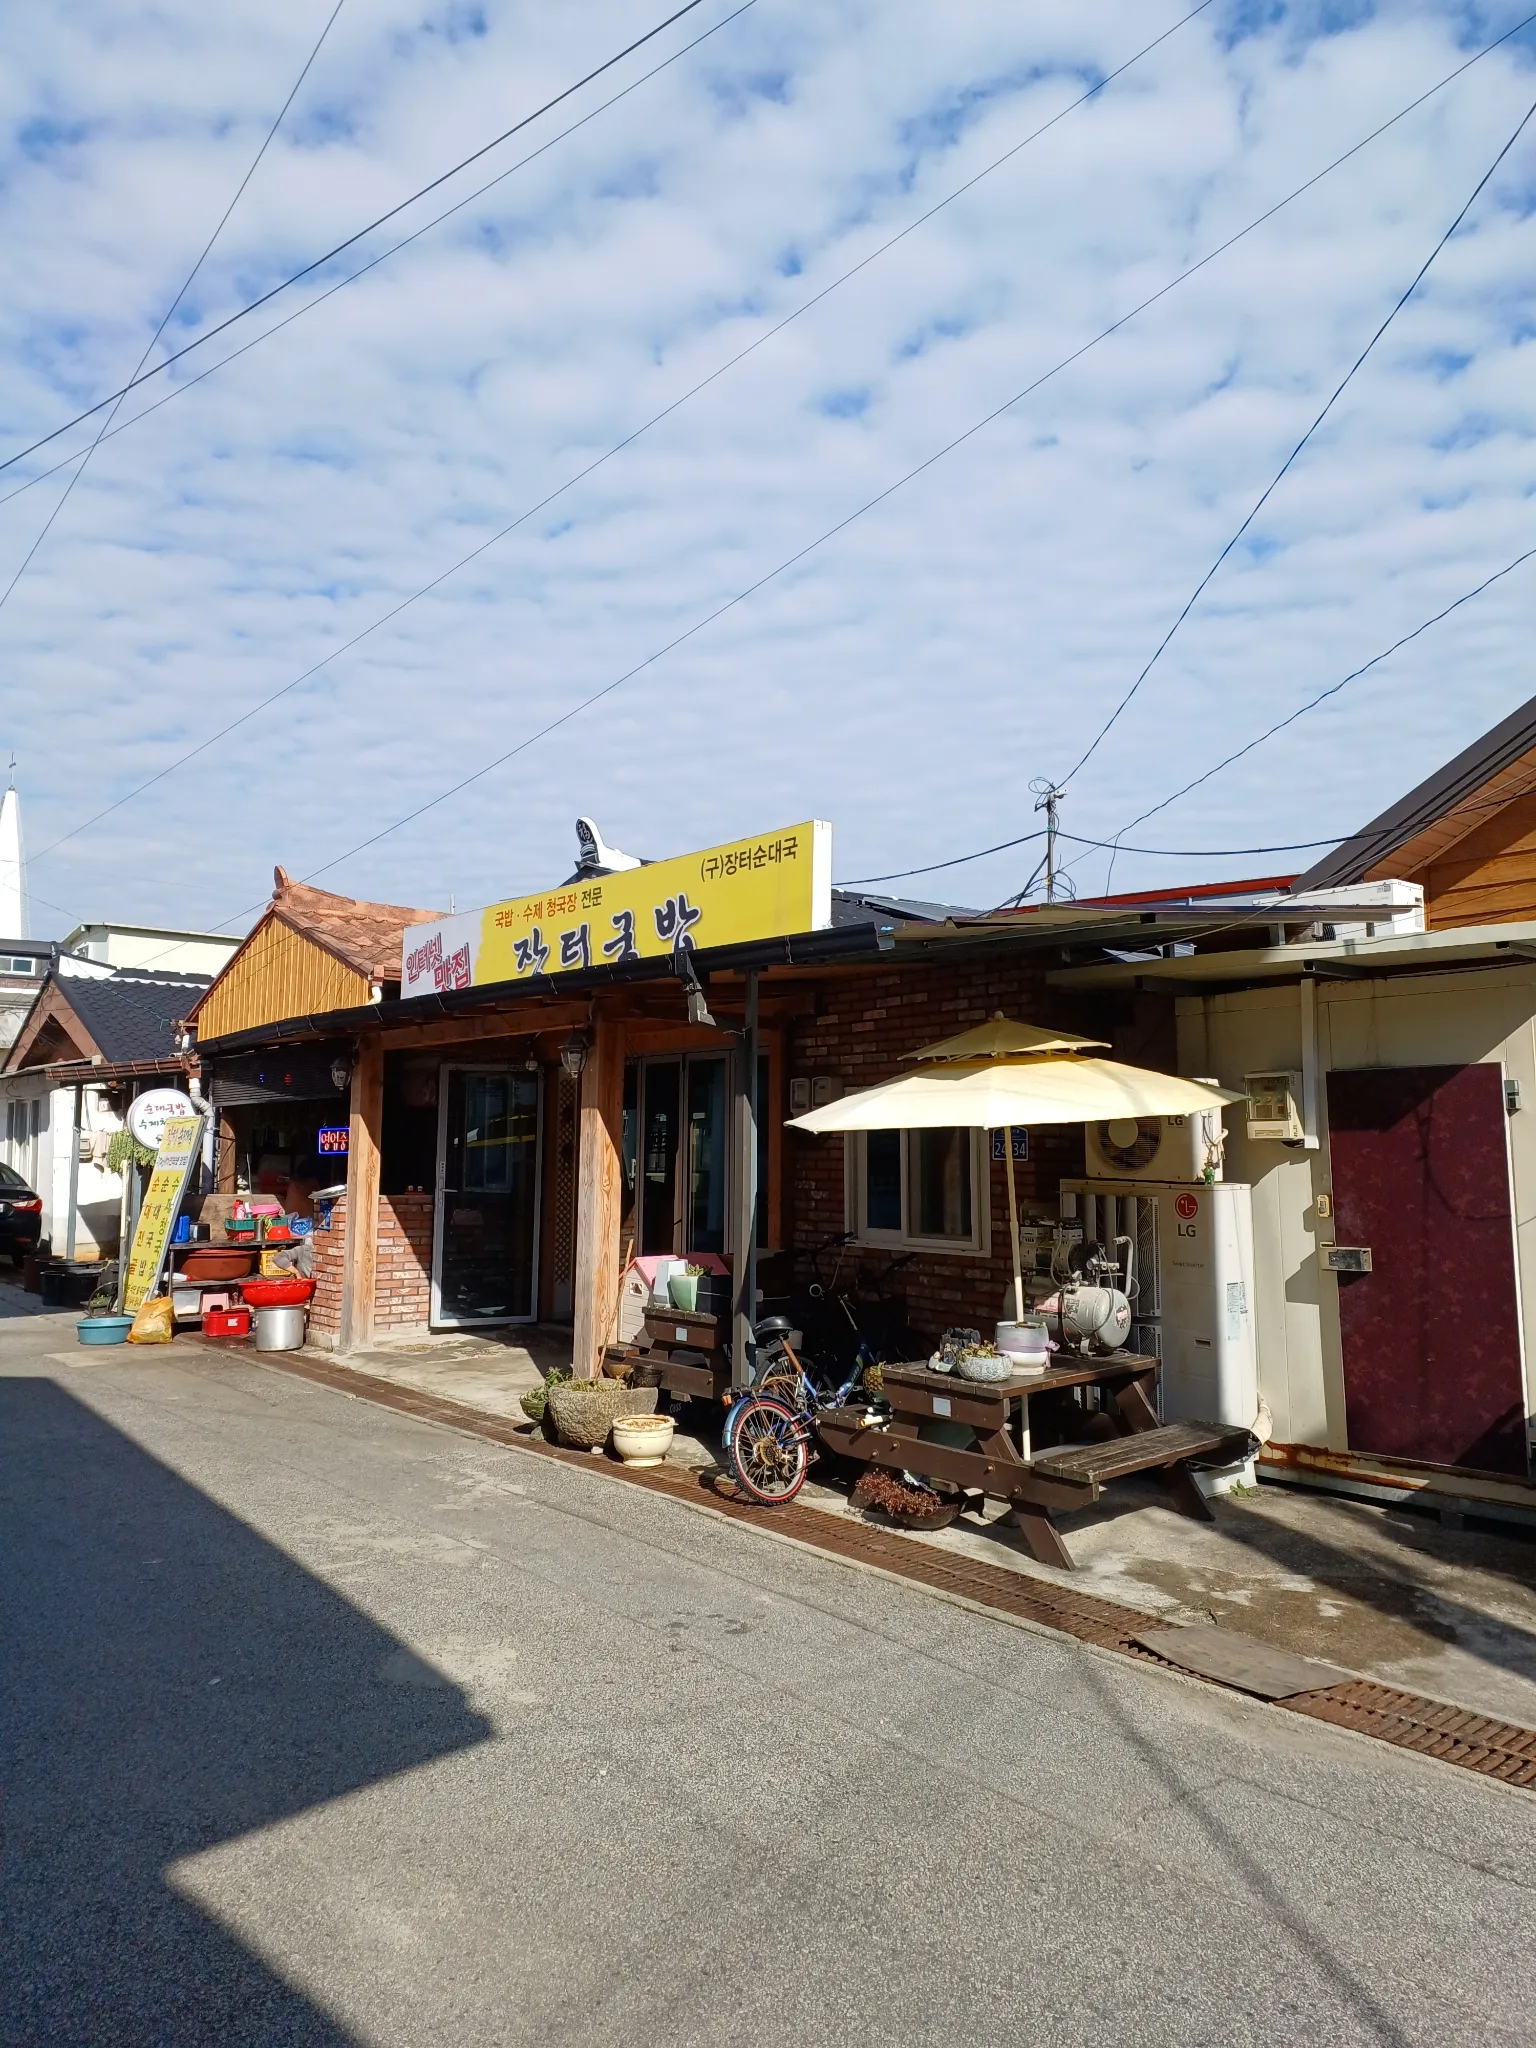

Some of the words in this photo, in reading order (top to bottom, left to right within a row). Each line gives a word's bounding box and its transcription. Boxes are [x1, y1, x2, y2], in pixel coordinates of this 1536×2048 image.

[701, 836, 798, 882] (구)장터순대국
[495, 909, 514, 928] 국밥
[523, 901, 543, 922] 수제
[547, 892, 577, 918] 청국장
[581, 887, 603, 909] 전문
[513, 893, 700, 976] 장터국밥
[406, 932, 442, 984] 인터넷
[434, 943, 472, 992] 맛집
[144, 1103, 187, 1116] 순대국밥
[1167, 1116, 1184, 1126] LG
[320, 1131, 348, 1151] 영업중
[138, 1175, 170, 1277] 순대국밥
[1177, 1224, 1197, 1237] LG
